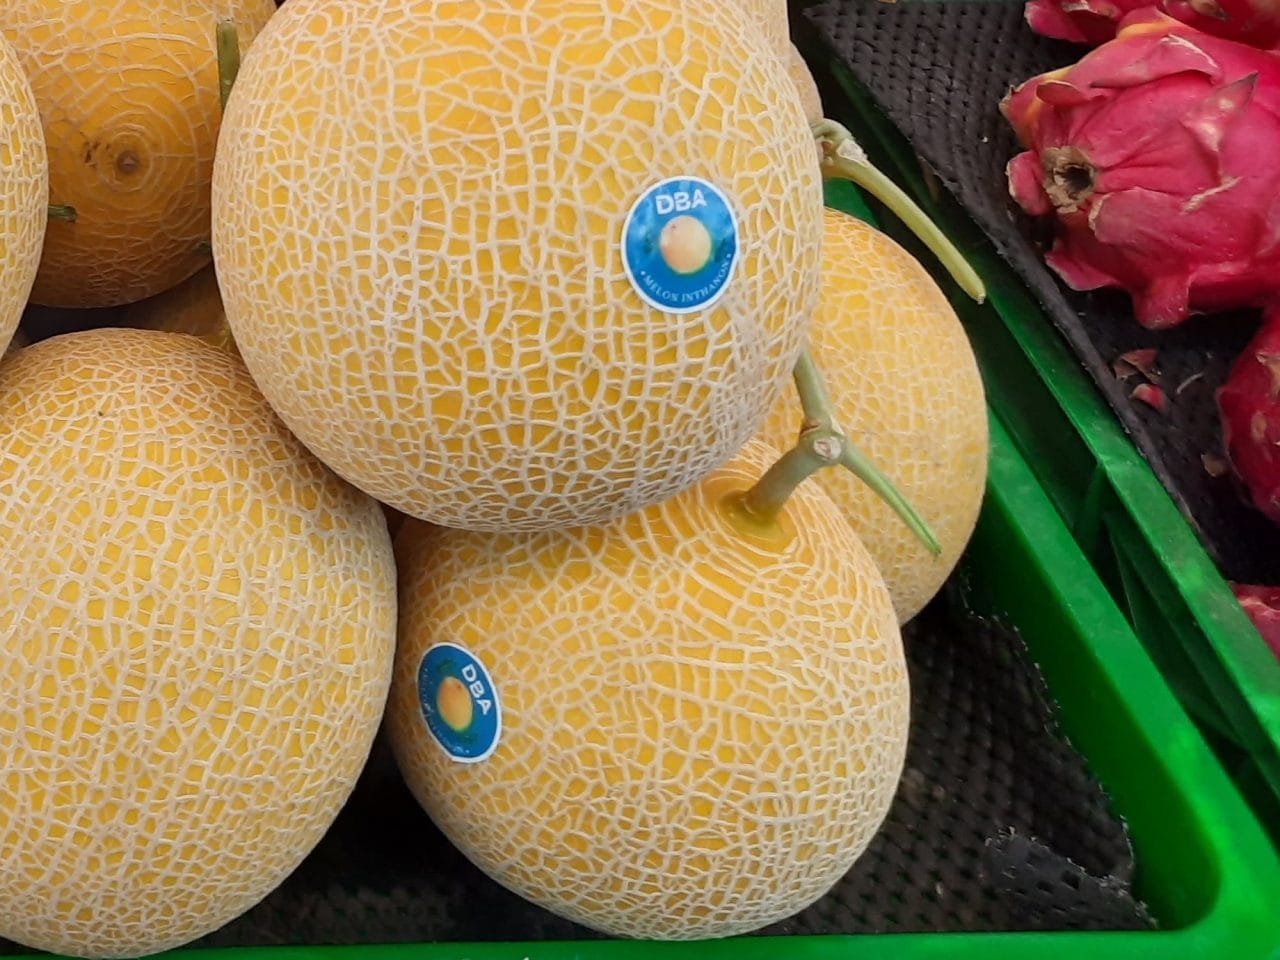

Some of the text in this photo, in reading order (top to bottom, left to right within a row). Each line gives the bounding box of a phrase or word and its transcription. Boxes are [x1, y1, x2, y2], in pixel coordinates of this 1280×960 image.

[655, 189, 708, 215] DBA
[643, 261, 730, 303] MELON INTHANON
[461, 663, 492, 716] DBA
